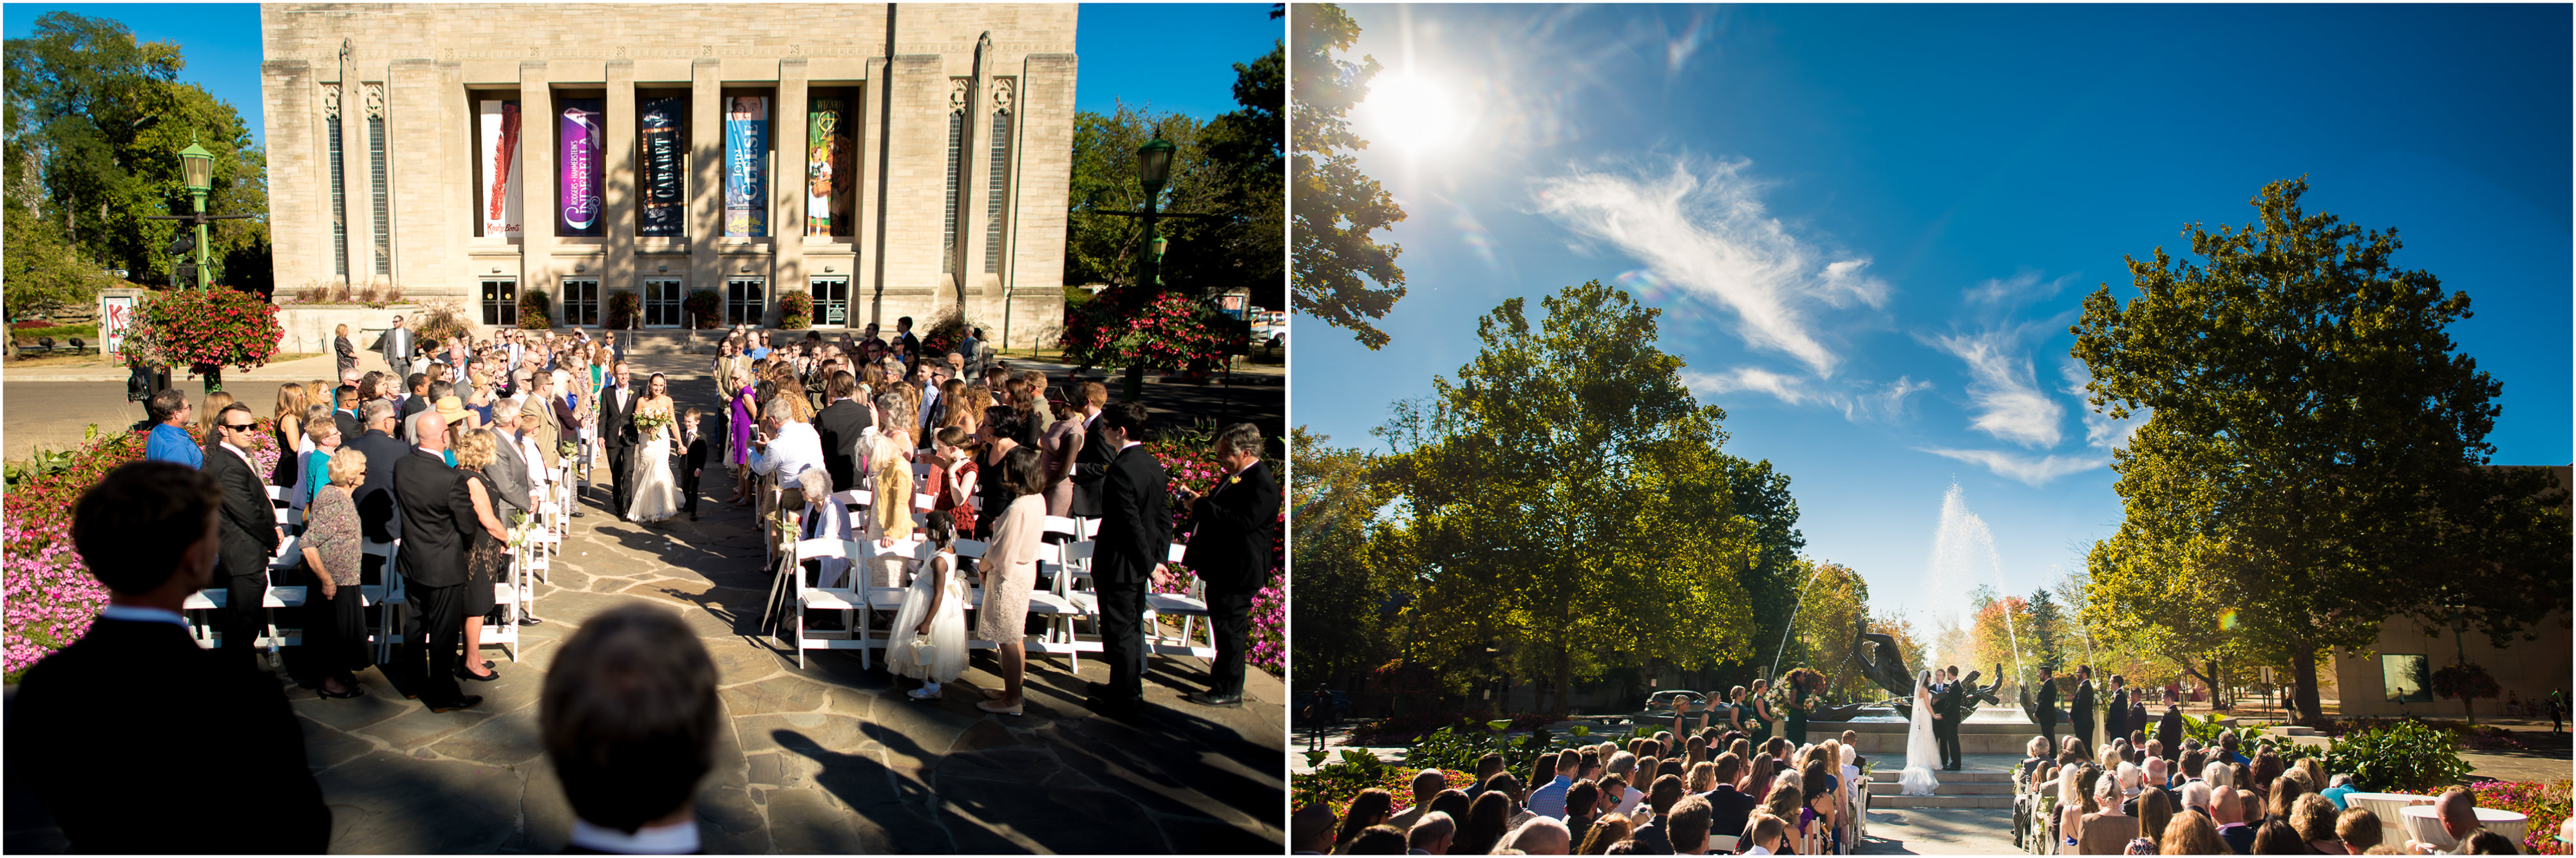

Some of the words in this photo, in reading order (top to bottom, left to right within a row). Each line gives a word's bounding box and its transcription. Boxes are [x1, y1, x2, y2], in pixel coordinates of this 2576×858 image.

[565, 136, 600, 230] CINDERELLA
[656, 138, 675, 198] CABARET
[734, 149, 744, 177] JOHN
[741, 124, 758, 201] CLEESE
[487, 223, 505, 235] Kinky
[505, 223, 520, 232] Boots
